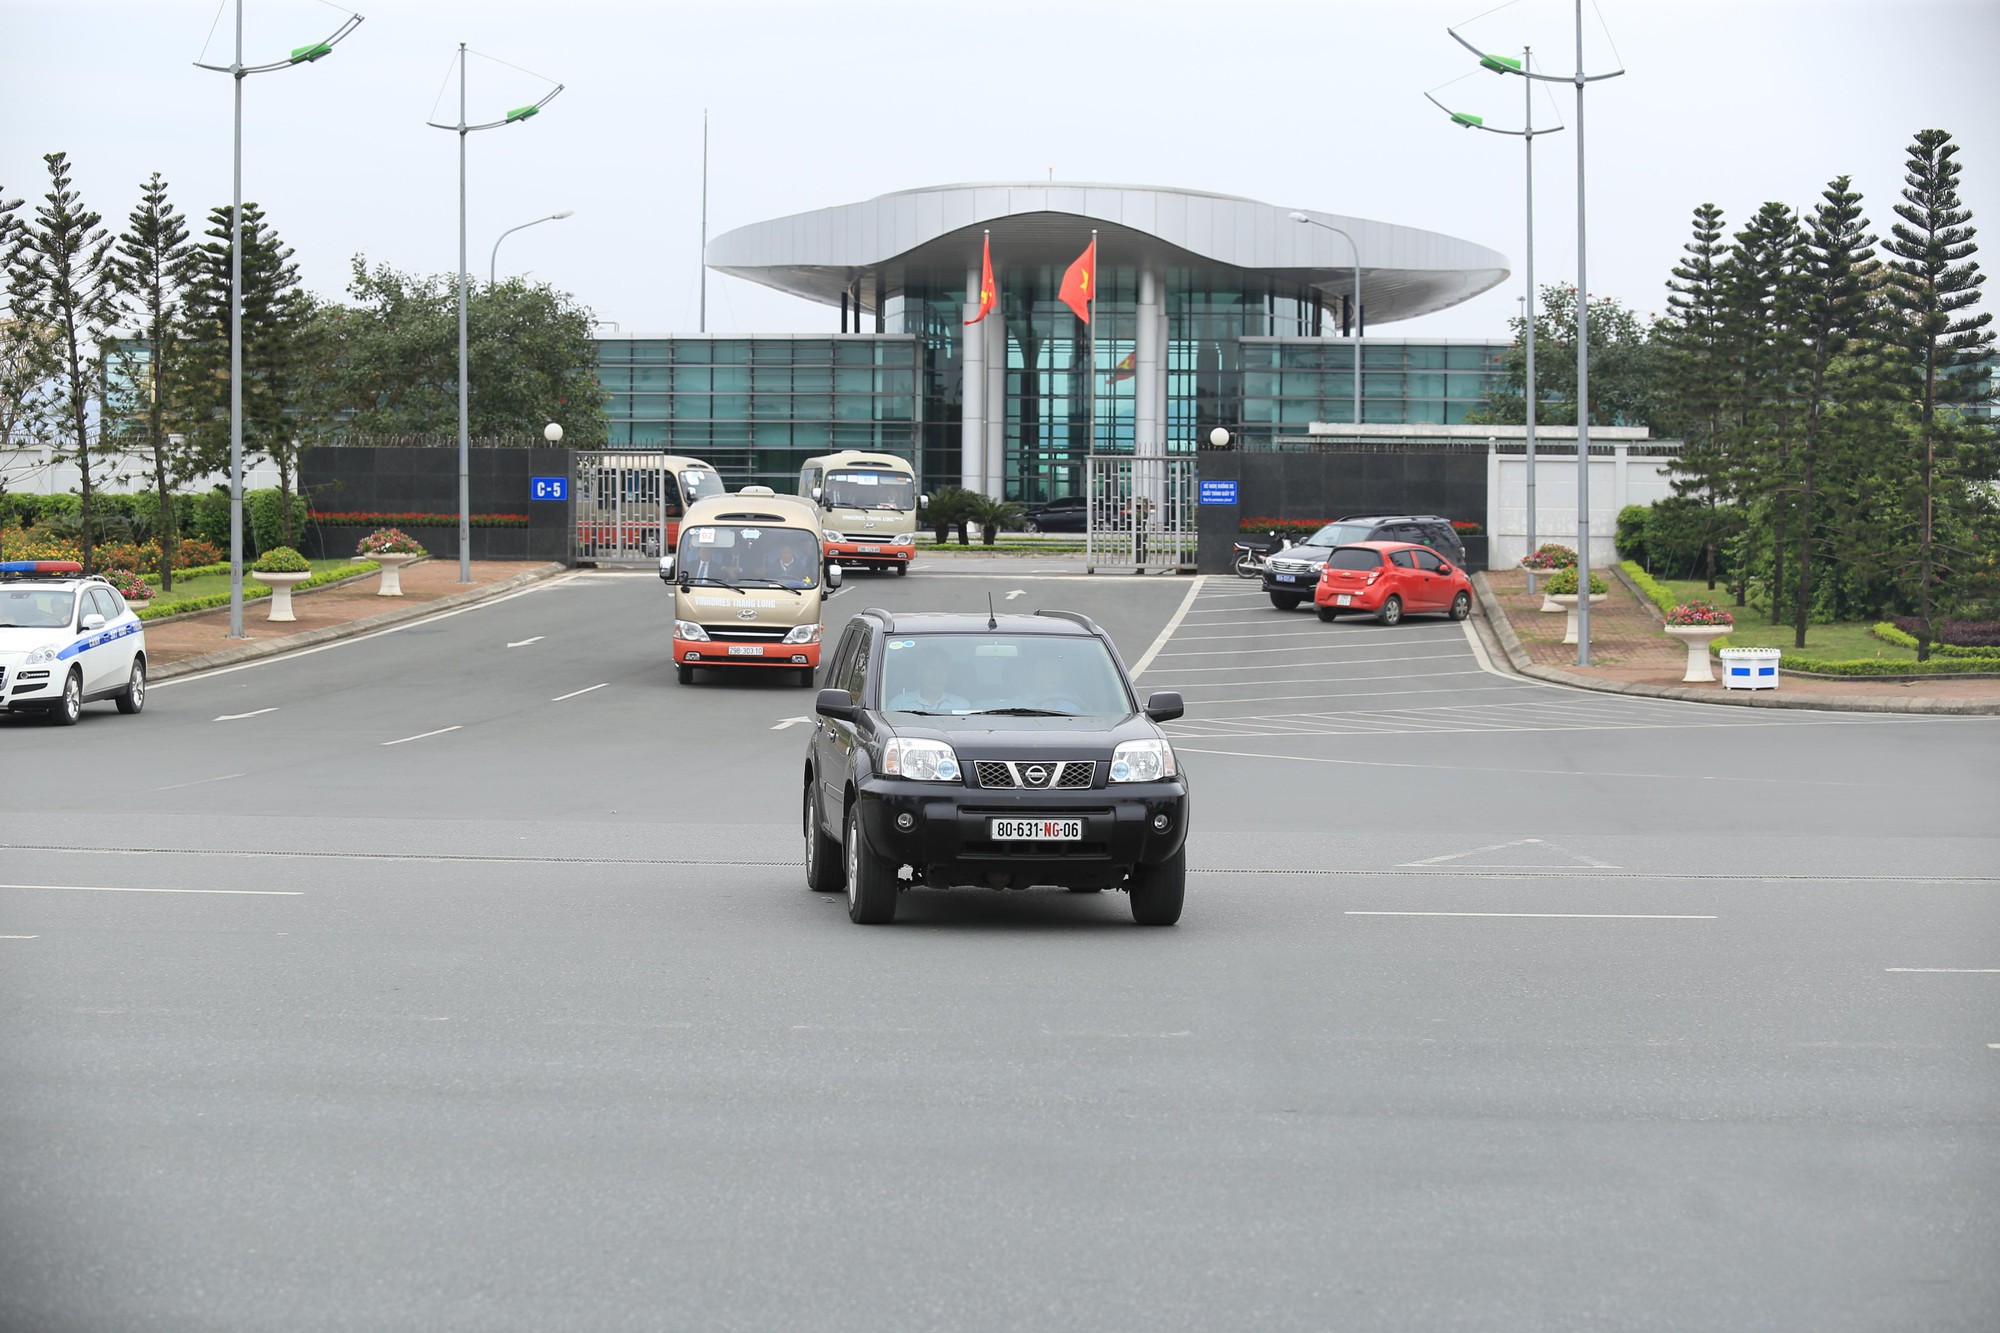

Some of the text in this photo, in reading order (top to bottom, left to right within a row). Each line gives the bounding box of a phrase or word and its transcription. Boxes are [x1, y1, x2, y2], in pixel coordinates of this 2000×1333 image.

[537, 481, 561, 497] C-5
[695, 596, 731, 607] VINHOMES
[757, 599, 776, 608] LONG
[997, 822, 1079, 837] 80-631-NG-06
